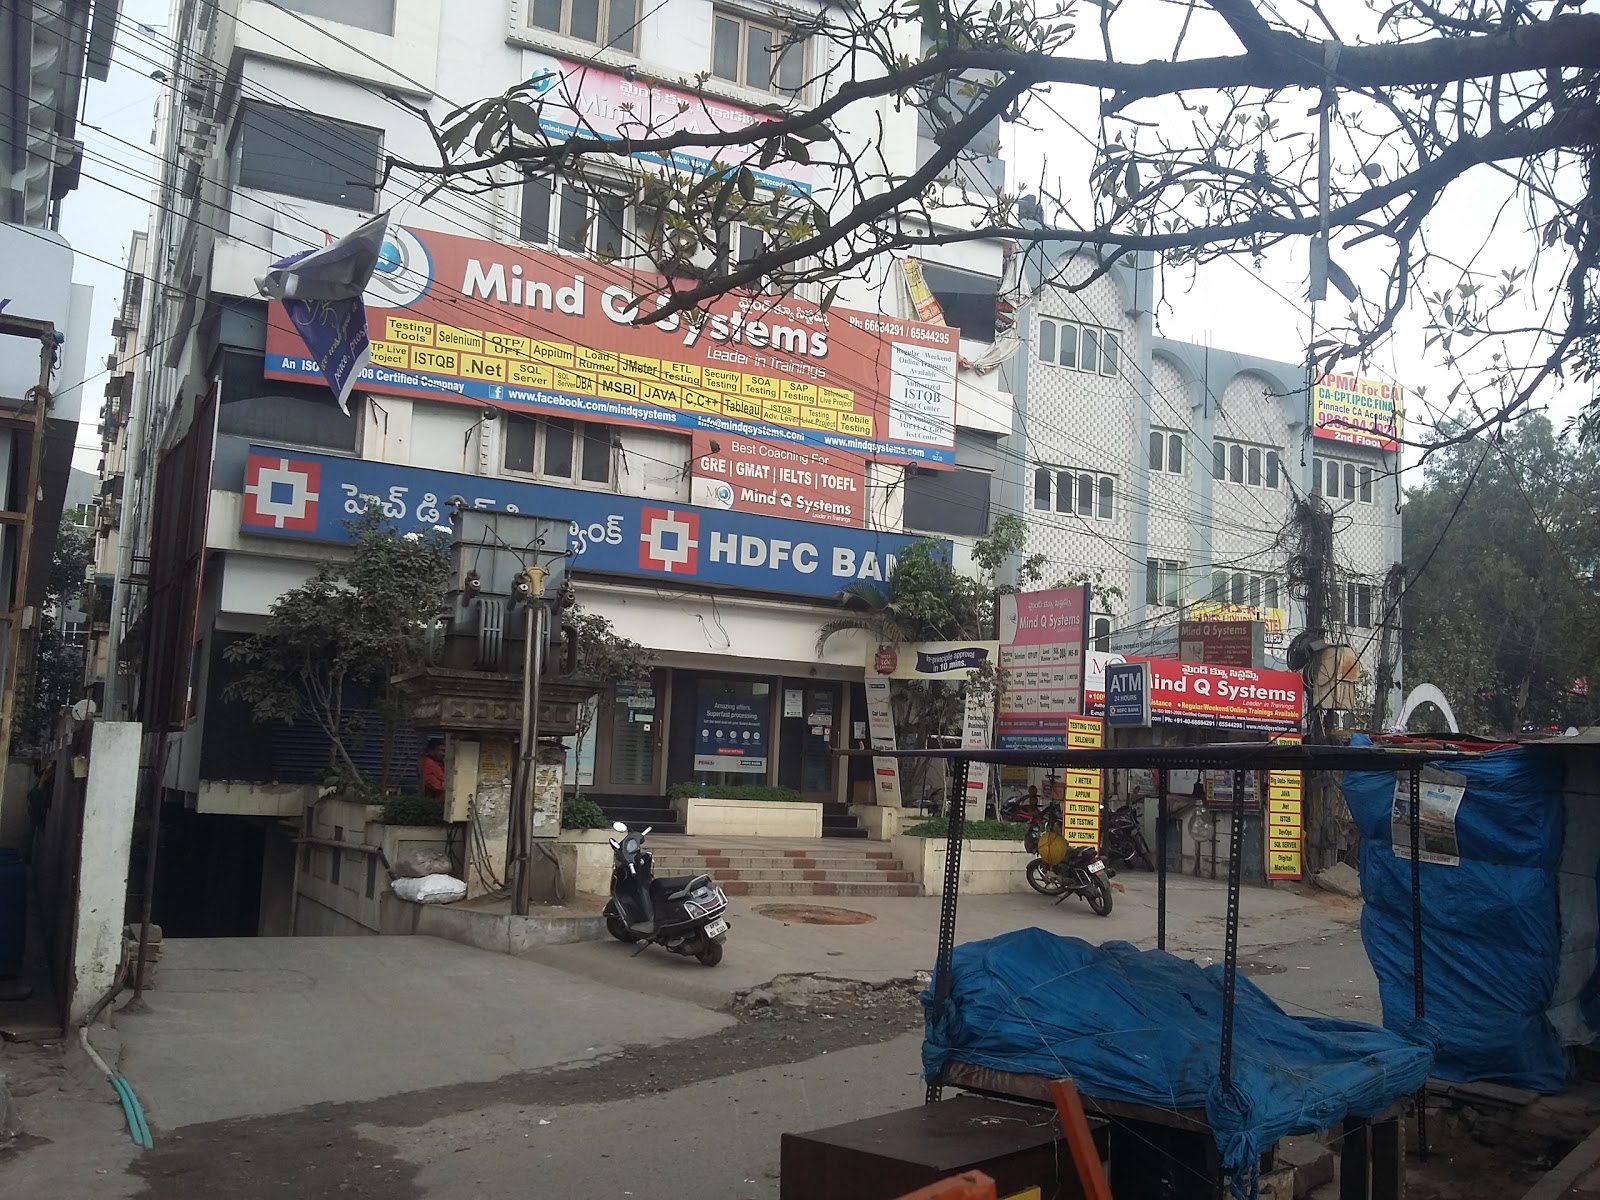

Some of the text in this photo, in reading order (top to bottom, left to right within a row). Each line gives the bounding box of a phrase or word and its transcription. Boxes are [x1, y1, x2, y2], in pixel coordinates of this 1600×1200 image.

[461, 258, 586, 316] Mind
[601, 285, 640, 327] Q
[388, 319, 432, 336] Testing
[849, 315, 863, 328] Ph:
[910, 328, 950, 344] 65544295
[394, 330, 426, 343] Tools
[439, 331, 481, 348] Selenium
[386, 345, 407, 355] Live
[533, 344, 572, 361] Appium
[585, 349, 610, 361] Load
[414, 351, 455, 369] ISTQB
[579, 359, 615, 373] Runner
[707, 345, 826, 380] Leader in Trainings
[281, 357, 296, 370] An
[376, 367, 419, 387] Certified
[465, 359, 502, 377] .Net
[519, 364, 541, 375] SQL
[672, 363, 692, 374] ETL
[513, 372, 547, 386] Server
[557, 371, 569, 380] SQL
[575, 374, 593, 391] DBA
[664, 372, 700, 386] Testing
[704, 369, 740, 383] Security
[751, 376, 771, 387] SOA
[602, 379, 636, 396] MSBI
[706, 378, 737, 392] Testing
[746, 385, 776, 398] Testing
[789, 382, 809, 392] SAP
[644, 386, 678, 402] JAVA
[783, 391, 815, 404] Testing
[904, 388, 941, 404] ISTQB
[1362, 384, 1379, 396] For
[1380, 384, 1400, 401] CA
[724, 399, 761, 416] Tableau
[820, 396, 852, 408] Live Project
[1318, 400, 1363, 417] Pinnacle CA
[808, 409, 830, 421] Testing
[842, 413, 870, 426] Mobile
[840, 423, 871, 436] Testing
[1334, 432, 1382, 448] 2nd Floor
[731, 440, 830, 466] Best Coaching For
[700, 455, 857, 492] GRE GMAT IELTS TOEFL
[741, 486, 852, 515] Mind Q Systems
[709, 531, 819, 574] HDFC
[1019, 613, 1081, 630] Mind Q Systems
[1181, 625, 1201, 637] Mind
[1203, 625, 1211, 636] Q
[1212, 624, 1248, 639] Systems
[926, 650, 976, 664] In-principle approval
[939, 662, 948, 671] 10
[948, 659, 967, 669] mins.
[1110, 672, 1142, 693] ATM
[1193, 679, 1297, 702] Q Systems
[1120, 694, 1138, 702] HOURS
[713, 702, 736, 711] Amazing
[706, 709, 758, 721] Superfast processing.
[1274, 710, 1299, 719] Available
[1069, 721, 1087, 731] TESTING
[1087, 723, 1101, 732] TOOLS
[1074, 736, 1096, 744] SELENIUM
[1077, 777, 1092, 785] METER
[1074, 790, 1091, 799] APPIUM
[1069, 804, 1096, 813] ETL TESTING
[1076, 817, 1094, 826] TESTING
[1068, 831, 1095, 840] SAP TESTING
[1278, 828, 1293, 837] DevOps
[1273, 841, 1297, 849] SQL SERVER
[1278, 854, 1293, 863] Digital
[1274, 863, 1297, 873] Marketing
